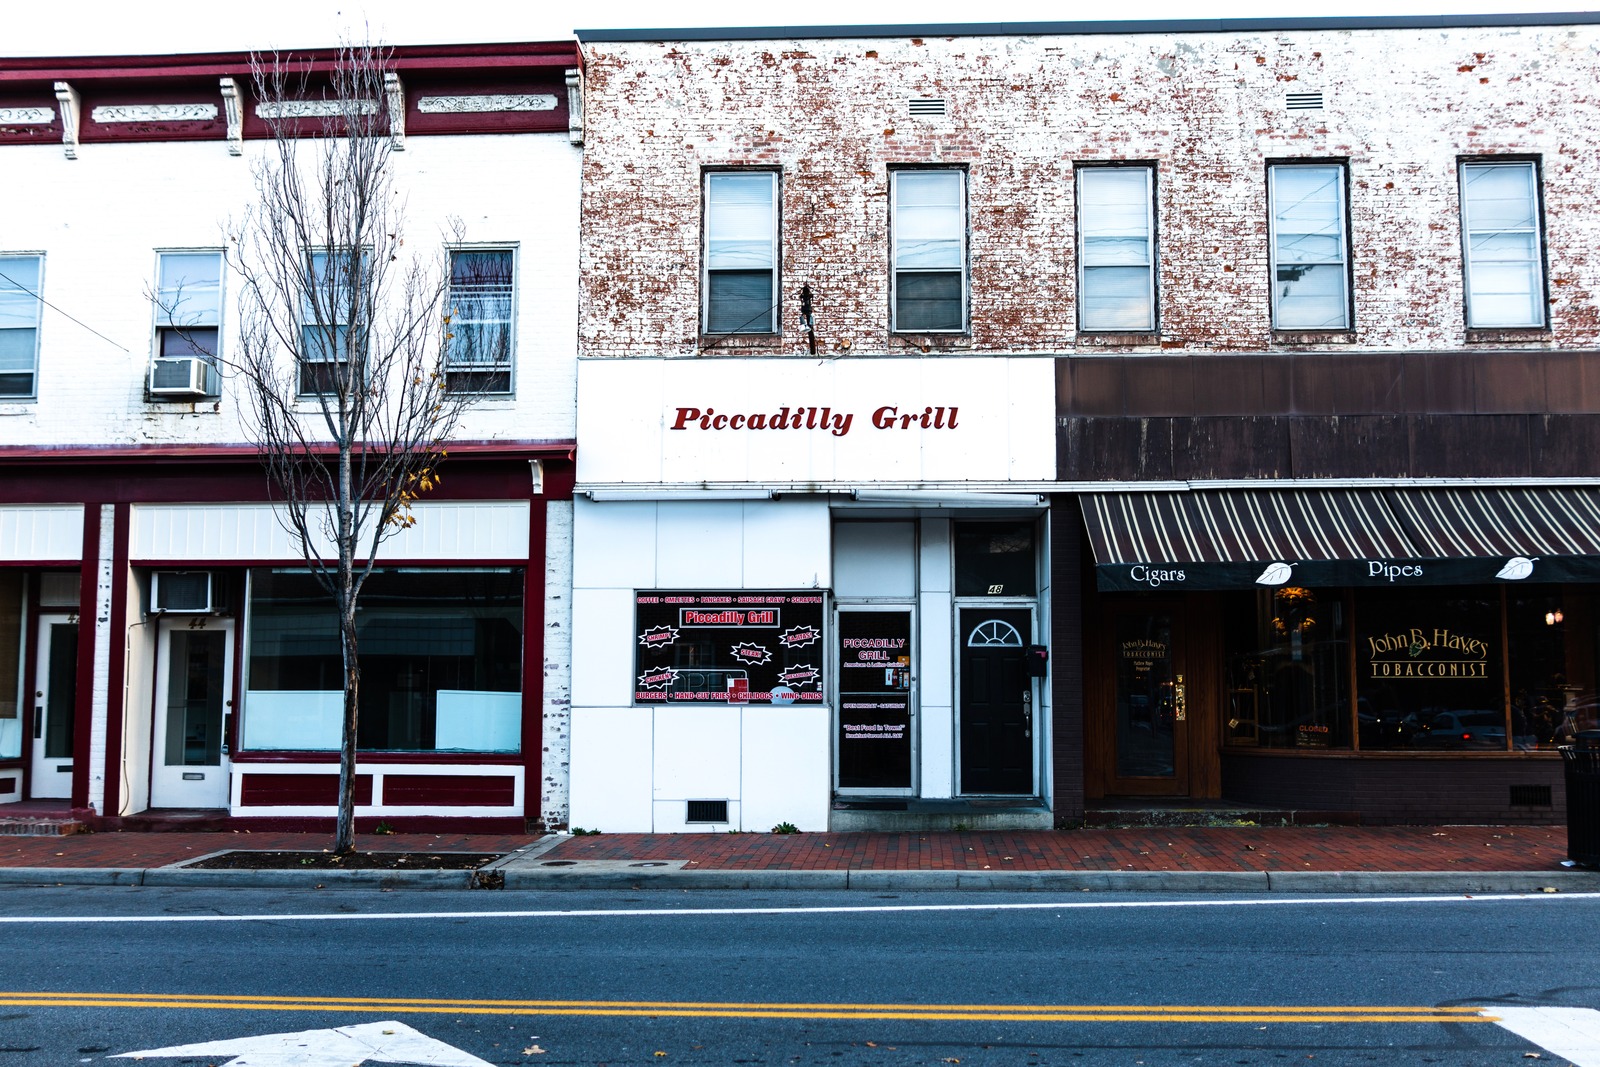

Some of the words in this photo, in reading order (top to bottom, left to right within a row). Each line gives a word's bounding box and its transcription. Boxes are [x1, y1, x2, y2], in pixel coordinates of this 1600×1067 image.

[670, 406, 854, 437] Piccadilly
[872, 406, 959, 430] Grill
[1130, 565, 1186, 587] Cigars
[1367, 560, 1423, 582] Pipes
[988, 585, 1003, 594] 48
[637, 596, 659, 604] COFFEE
[700, 596, 732, 604] PANCAKES
[737, 596, 765, 604] SAUSAGE
[765, 596, 786, 604] GRAVY
[791, 596, 822, 604] SCRAPPLE
[188, 617, 207, 629] 44
[685, 611, 745, 626] Piccadilly
[747, 611, 774, 624] Grill
[646, 632, 671, 642] SHRIMP!
[786, 631, 813, 642] FAJITAS!
[843, 638, 905, 649] PICCADILLY
[1368, 633, 1409, 660] John
[1433, 628, 1489, 660] Hayes
[741, 648, 762, 658] STEAK!
[858, 650, 890, 660] GRILL
[1371, 663, 1487, 677] TOBACCONIST
[645, 673, 672, 683] CHICKEN!
[635, 691, 667, 700] BURGERS
[675, 691, 710, 700] HAND-CUT
[711, 691, 731, 700] FRIES
[781, 691, 822, 700] WING-DINGS
[1298, 725, 1329, 733] CLOSED
